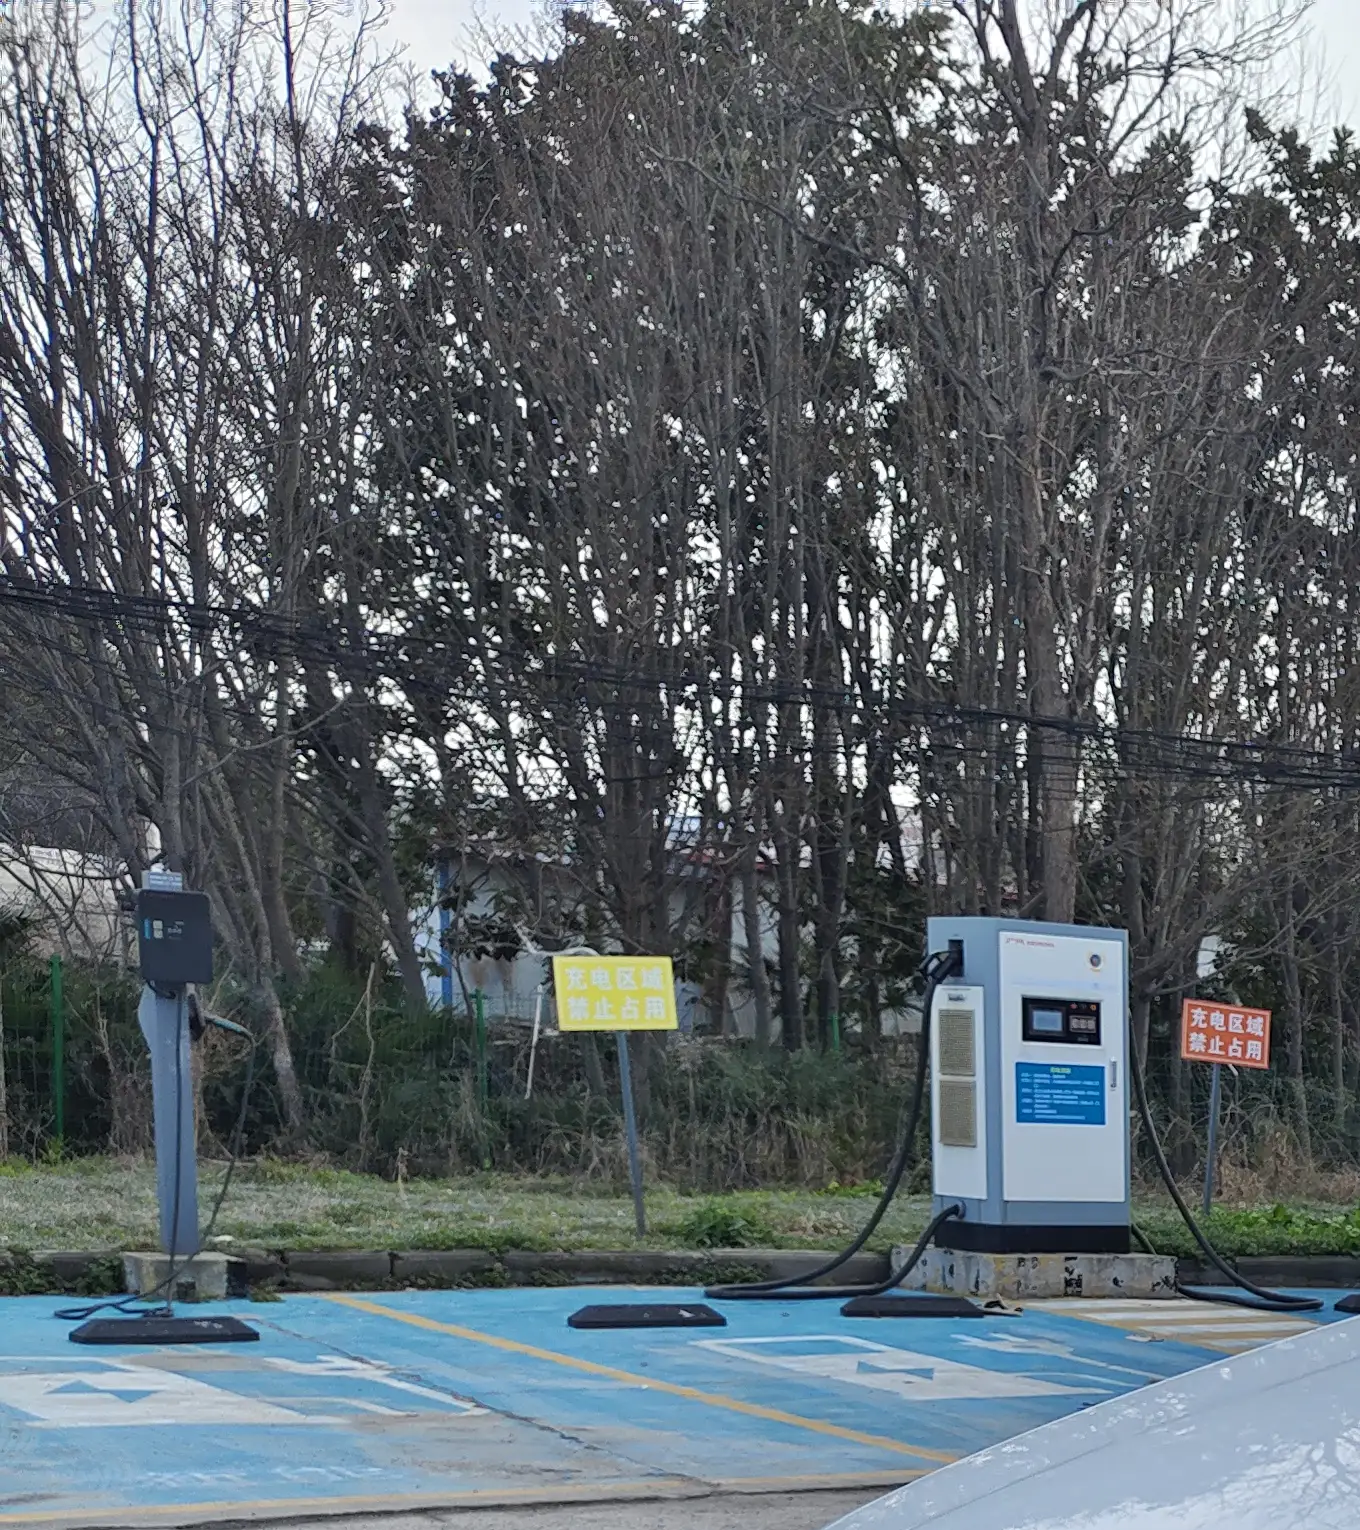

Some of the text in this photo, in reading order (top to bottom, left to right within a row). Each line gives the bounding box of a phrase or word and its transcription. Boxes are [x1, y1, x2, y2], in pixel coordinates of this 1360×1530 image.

[565, 965, 663, 991] 充电区域
[567, 995, 666, 1020] 禁止占用
[1190, 1007, 1264, 1037] 充电区域
[1188, 1031, 1262, 1061] 禁止占用
